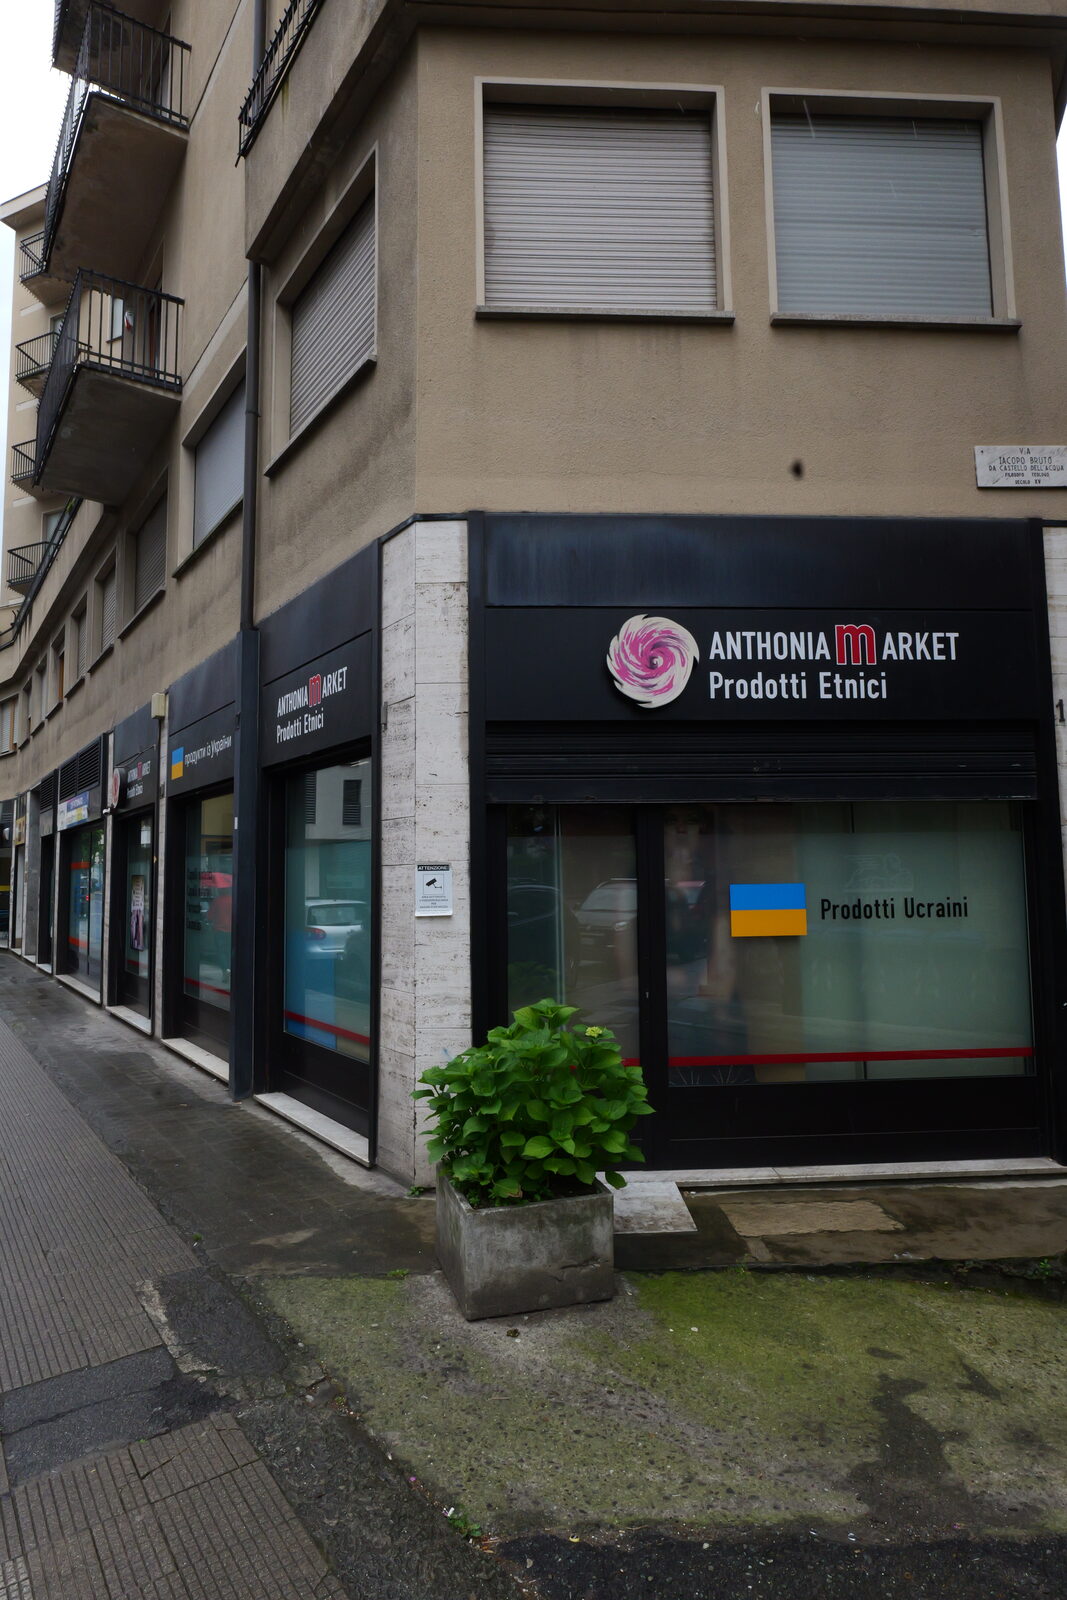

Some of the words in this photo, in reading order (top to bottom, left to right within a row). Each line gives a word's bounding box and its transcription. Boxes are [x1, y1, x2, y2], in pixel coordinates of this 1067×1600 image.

[999, 456, 1026, 465] IACOPO
[1030, 456, 1053, 465] BRUTO
[709, 630, 831, 661] ANTHONIA
[709, 671, 807, 700] Prodotti
[819, 671, 888, 700] Etnici
[277, 685, 308, 718] ANTHONIA
[1056, 699, 1066, 723] 1
[276, 716, 302, 744] Prodotti
[303, 707, 324, 734] Etnici
[820, 898, 895, 920] Prodotti
[904, 896, 968, 918] Ucraini
